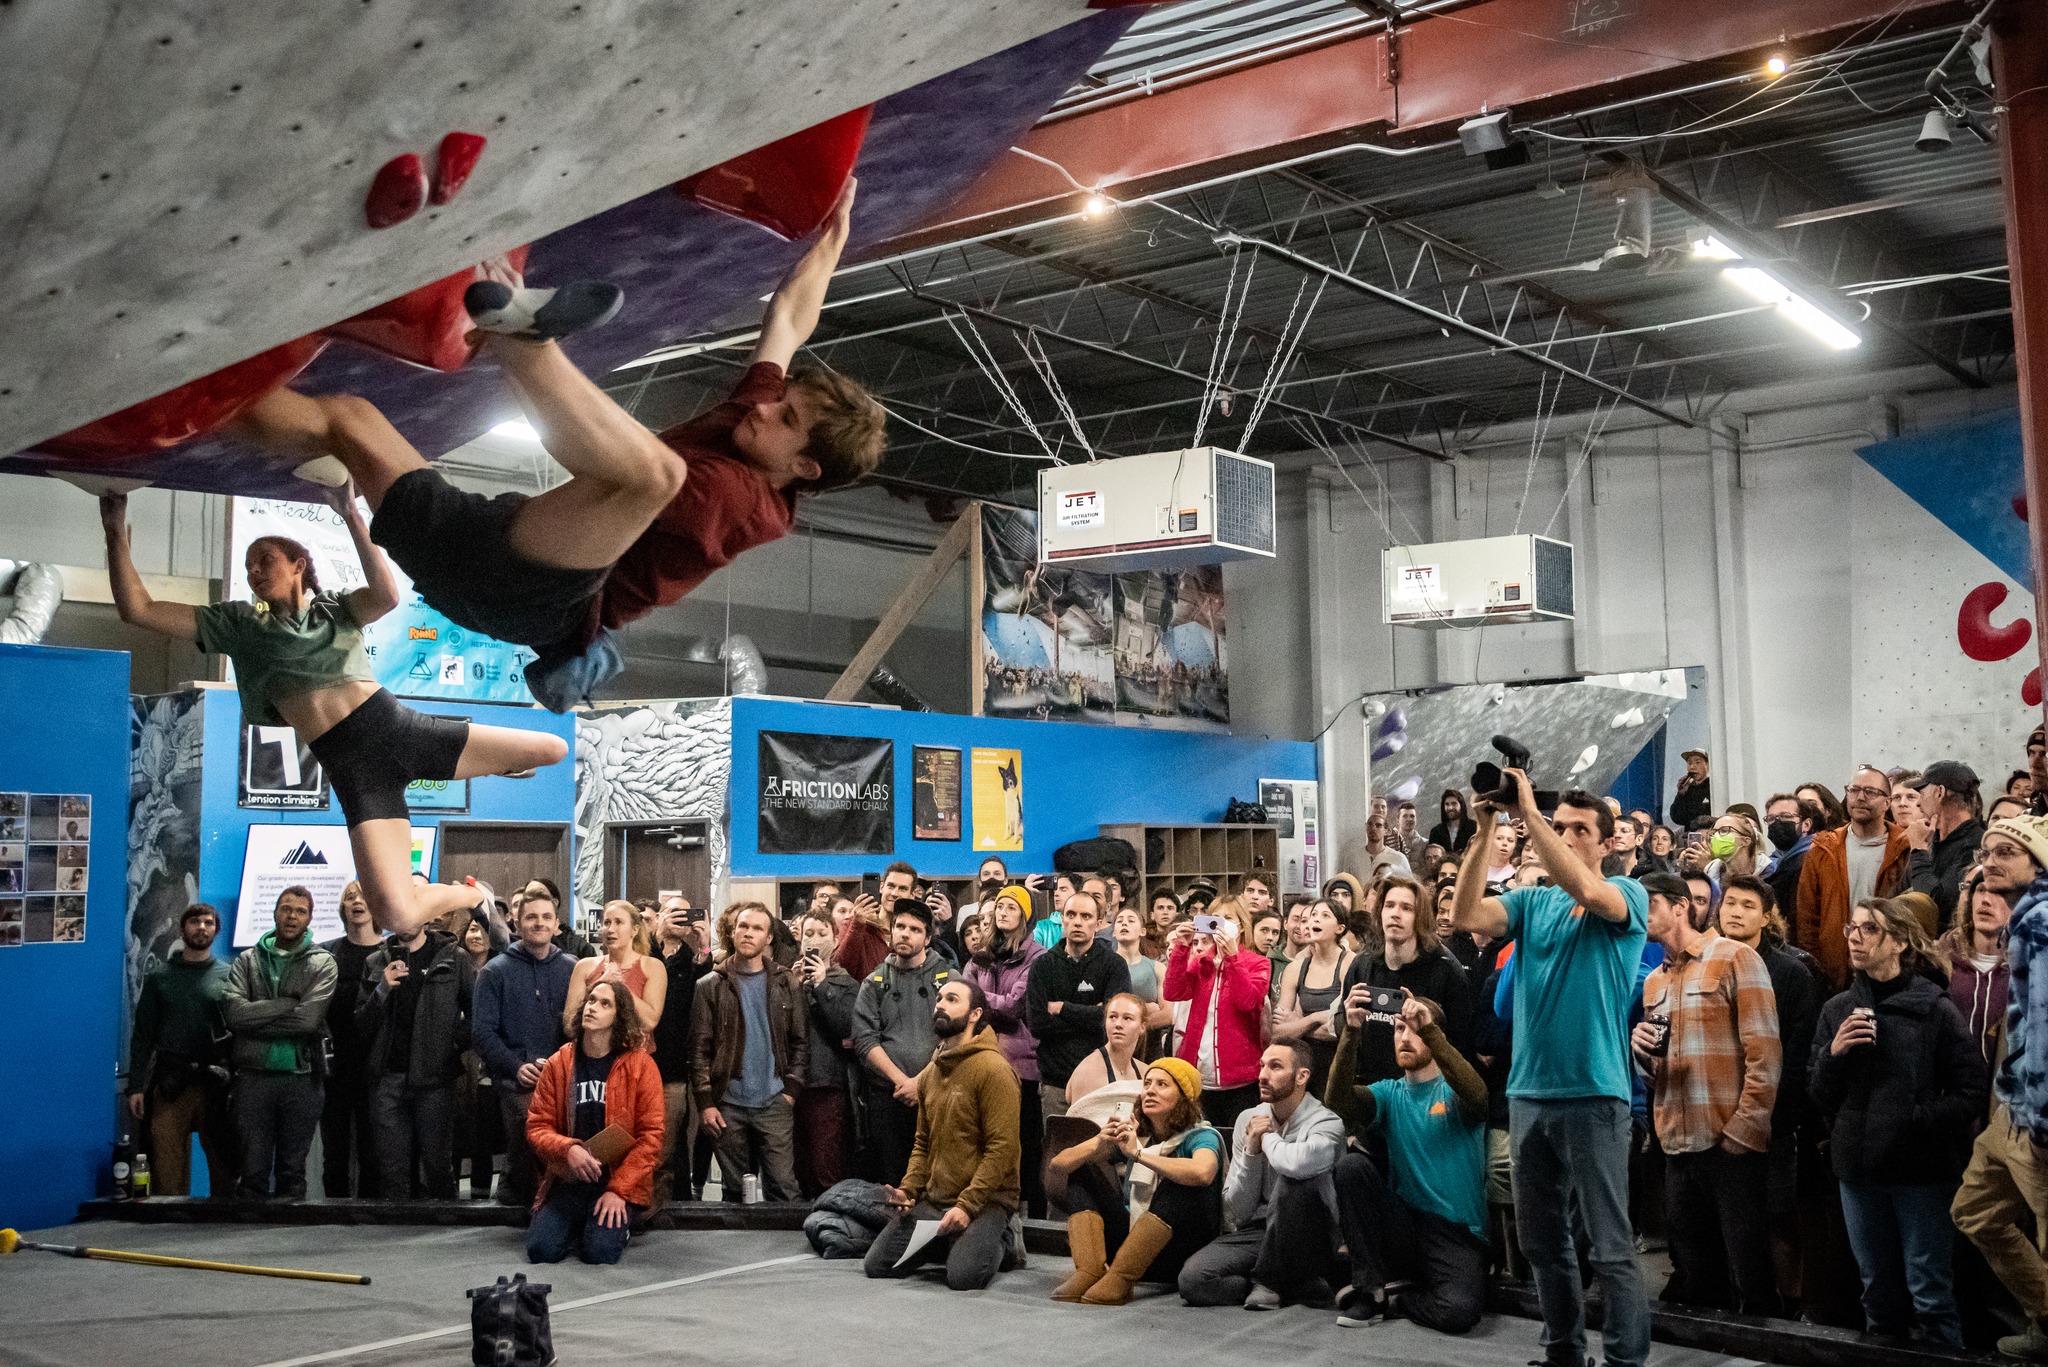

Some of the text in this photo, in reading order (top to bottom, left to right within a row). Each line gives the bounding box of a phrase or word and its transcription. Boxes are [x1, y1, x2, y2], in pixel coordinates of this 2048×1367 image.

[1065, 495, 1096, 508] JET
[1405, 571, 1432, 580] JET
[782, 780, 889, 800] FRICTIONLABS
[247, 793, 320, 808] tension climbing
[764, 797, 889, 811] THE NEW STANDARD IN CHALK
